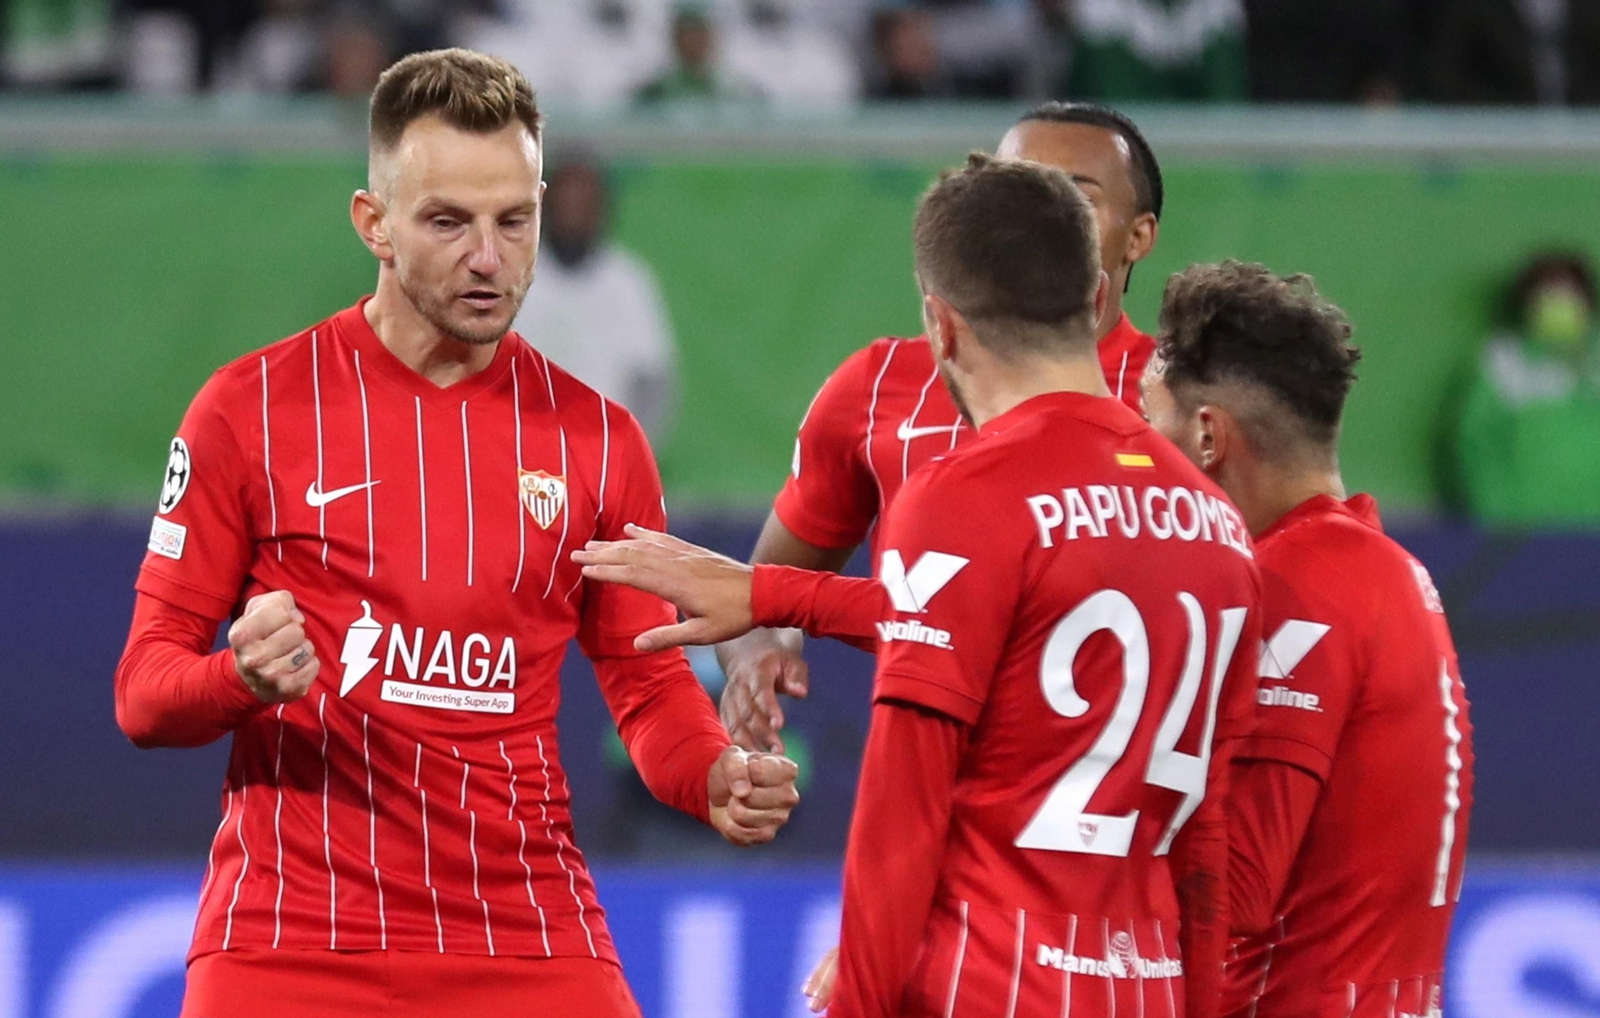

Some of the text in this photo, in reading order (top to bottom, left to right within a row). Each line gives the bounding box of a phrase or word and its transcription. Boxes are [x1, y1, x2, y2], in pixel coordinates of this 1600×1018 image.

[1026, 484, 1140, 548] PAPU
[384, 622, 517, 690] NAGA
[389, 685, 509, 710] Your Investing Super App
[1014, 587, 1248, 858] 24
